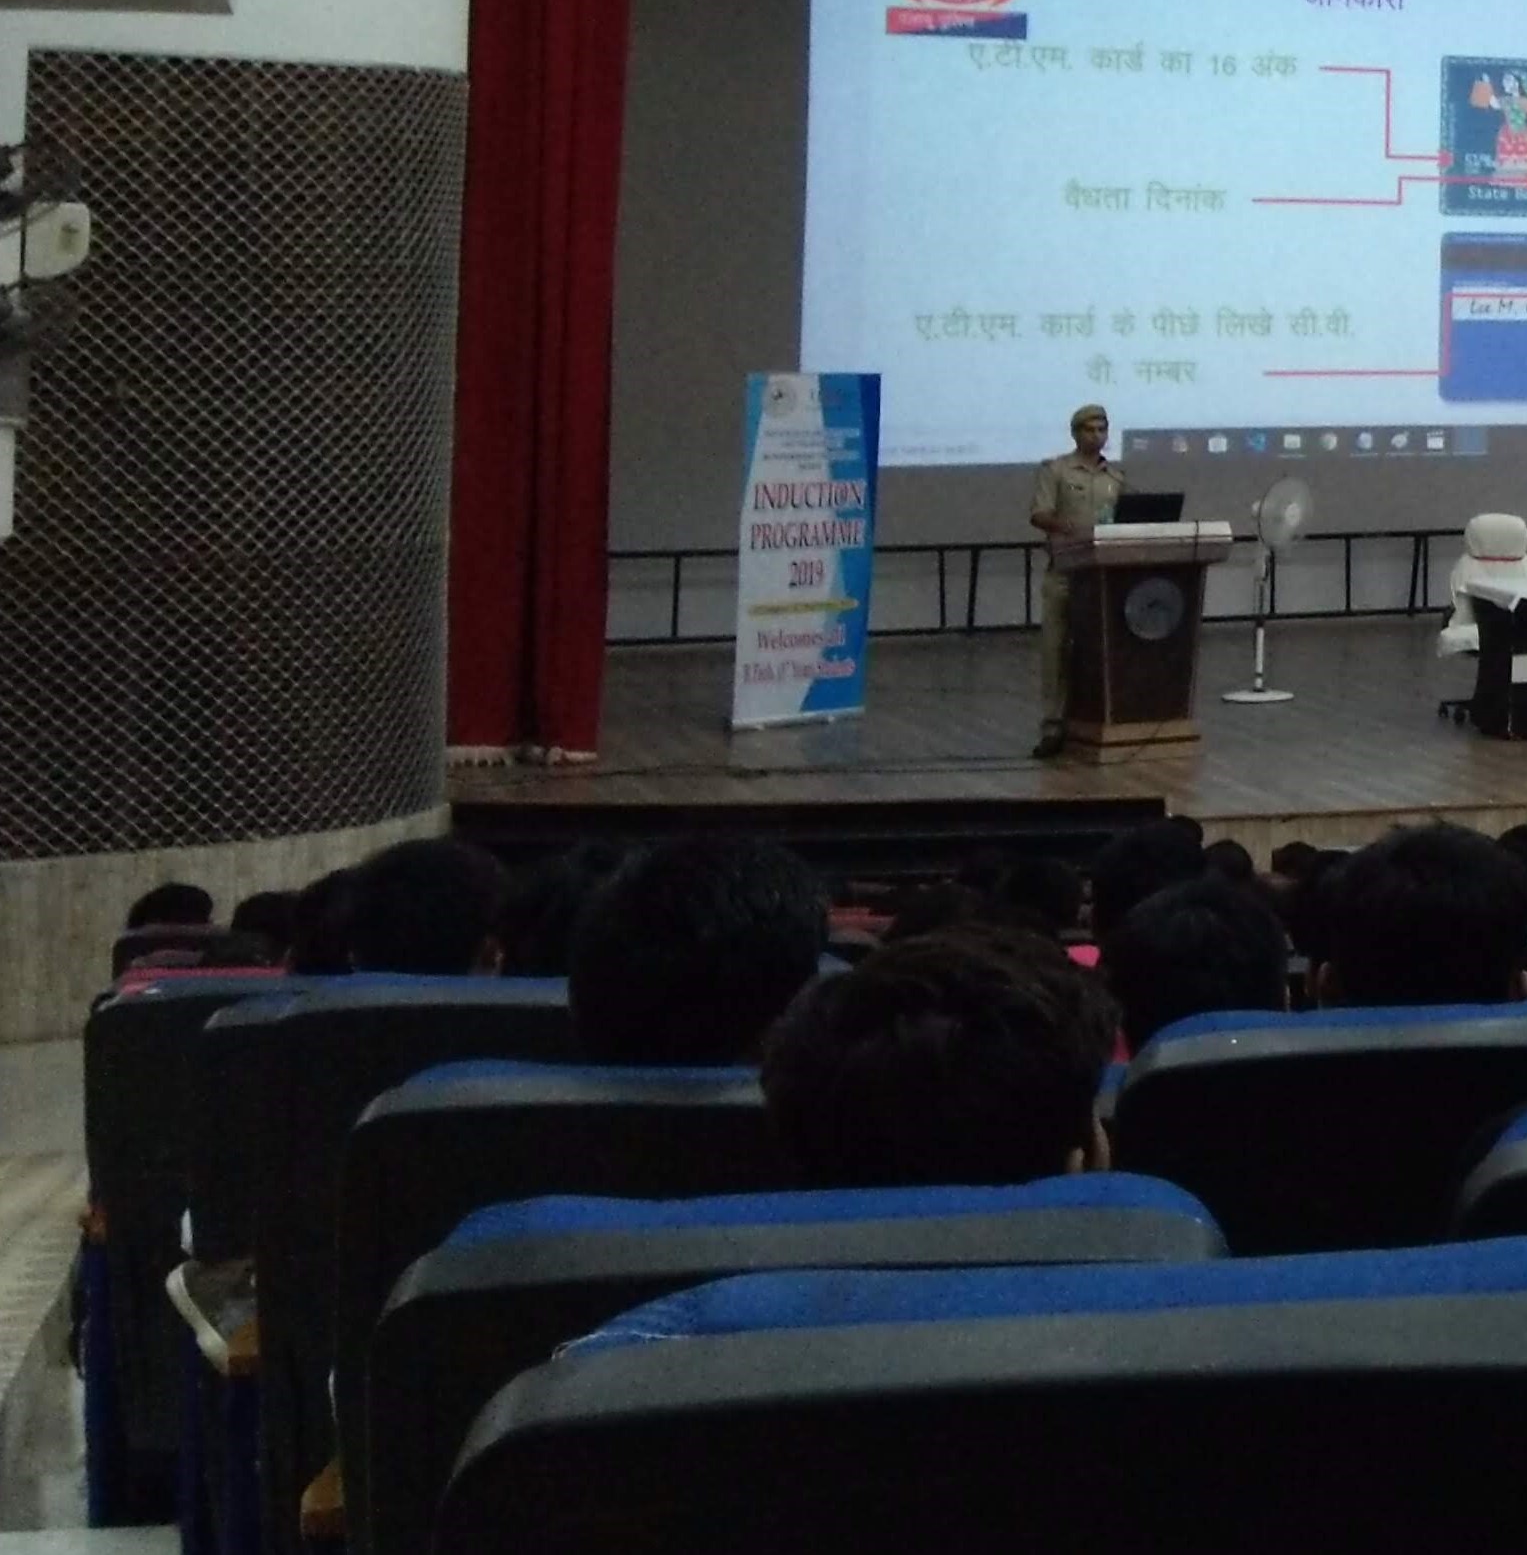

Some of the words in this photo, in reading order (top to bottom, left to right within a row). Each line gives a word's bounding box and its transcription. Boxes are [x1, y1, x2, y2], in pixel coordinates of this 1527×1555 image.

[1160, 50, 1193, 76] का
[1211, 54, 1237, 77] 16
[754, 480, 867, 511] INDUCTION
[751, 519, 865, 551] PROGRAMME
[788, 559, 825, 589] 2019
